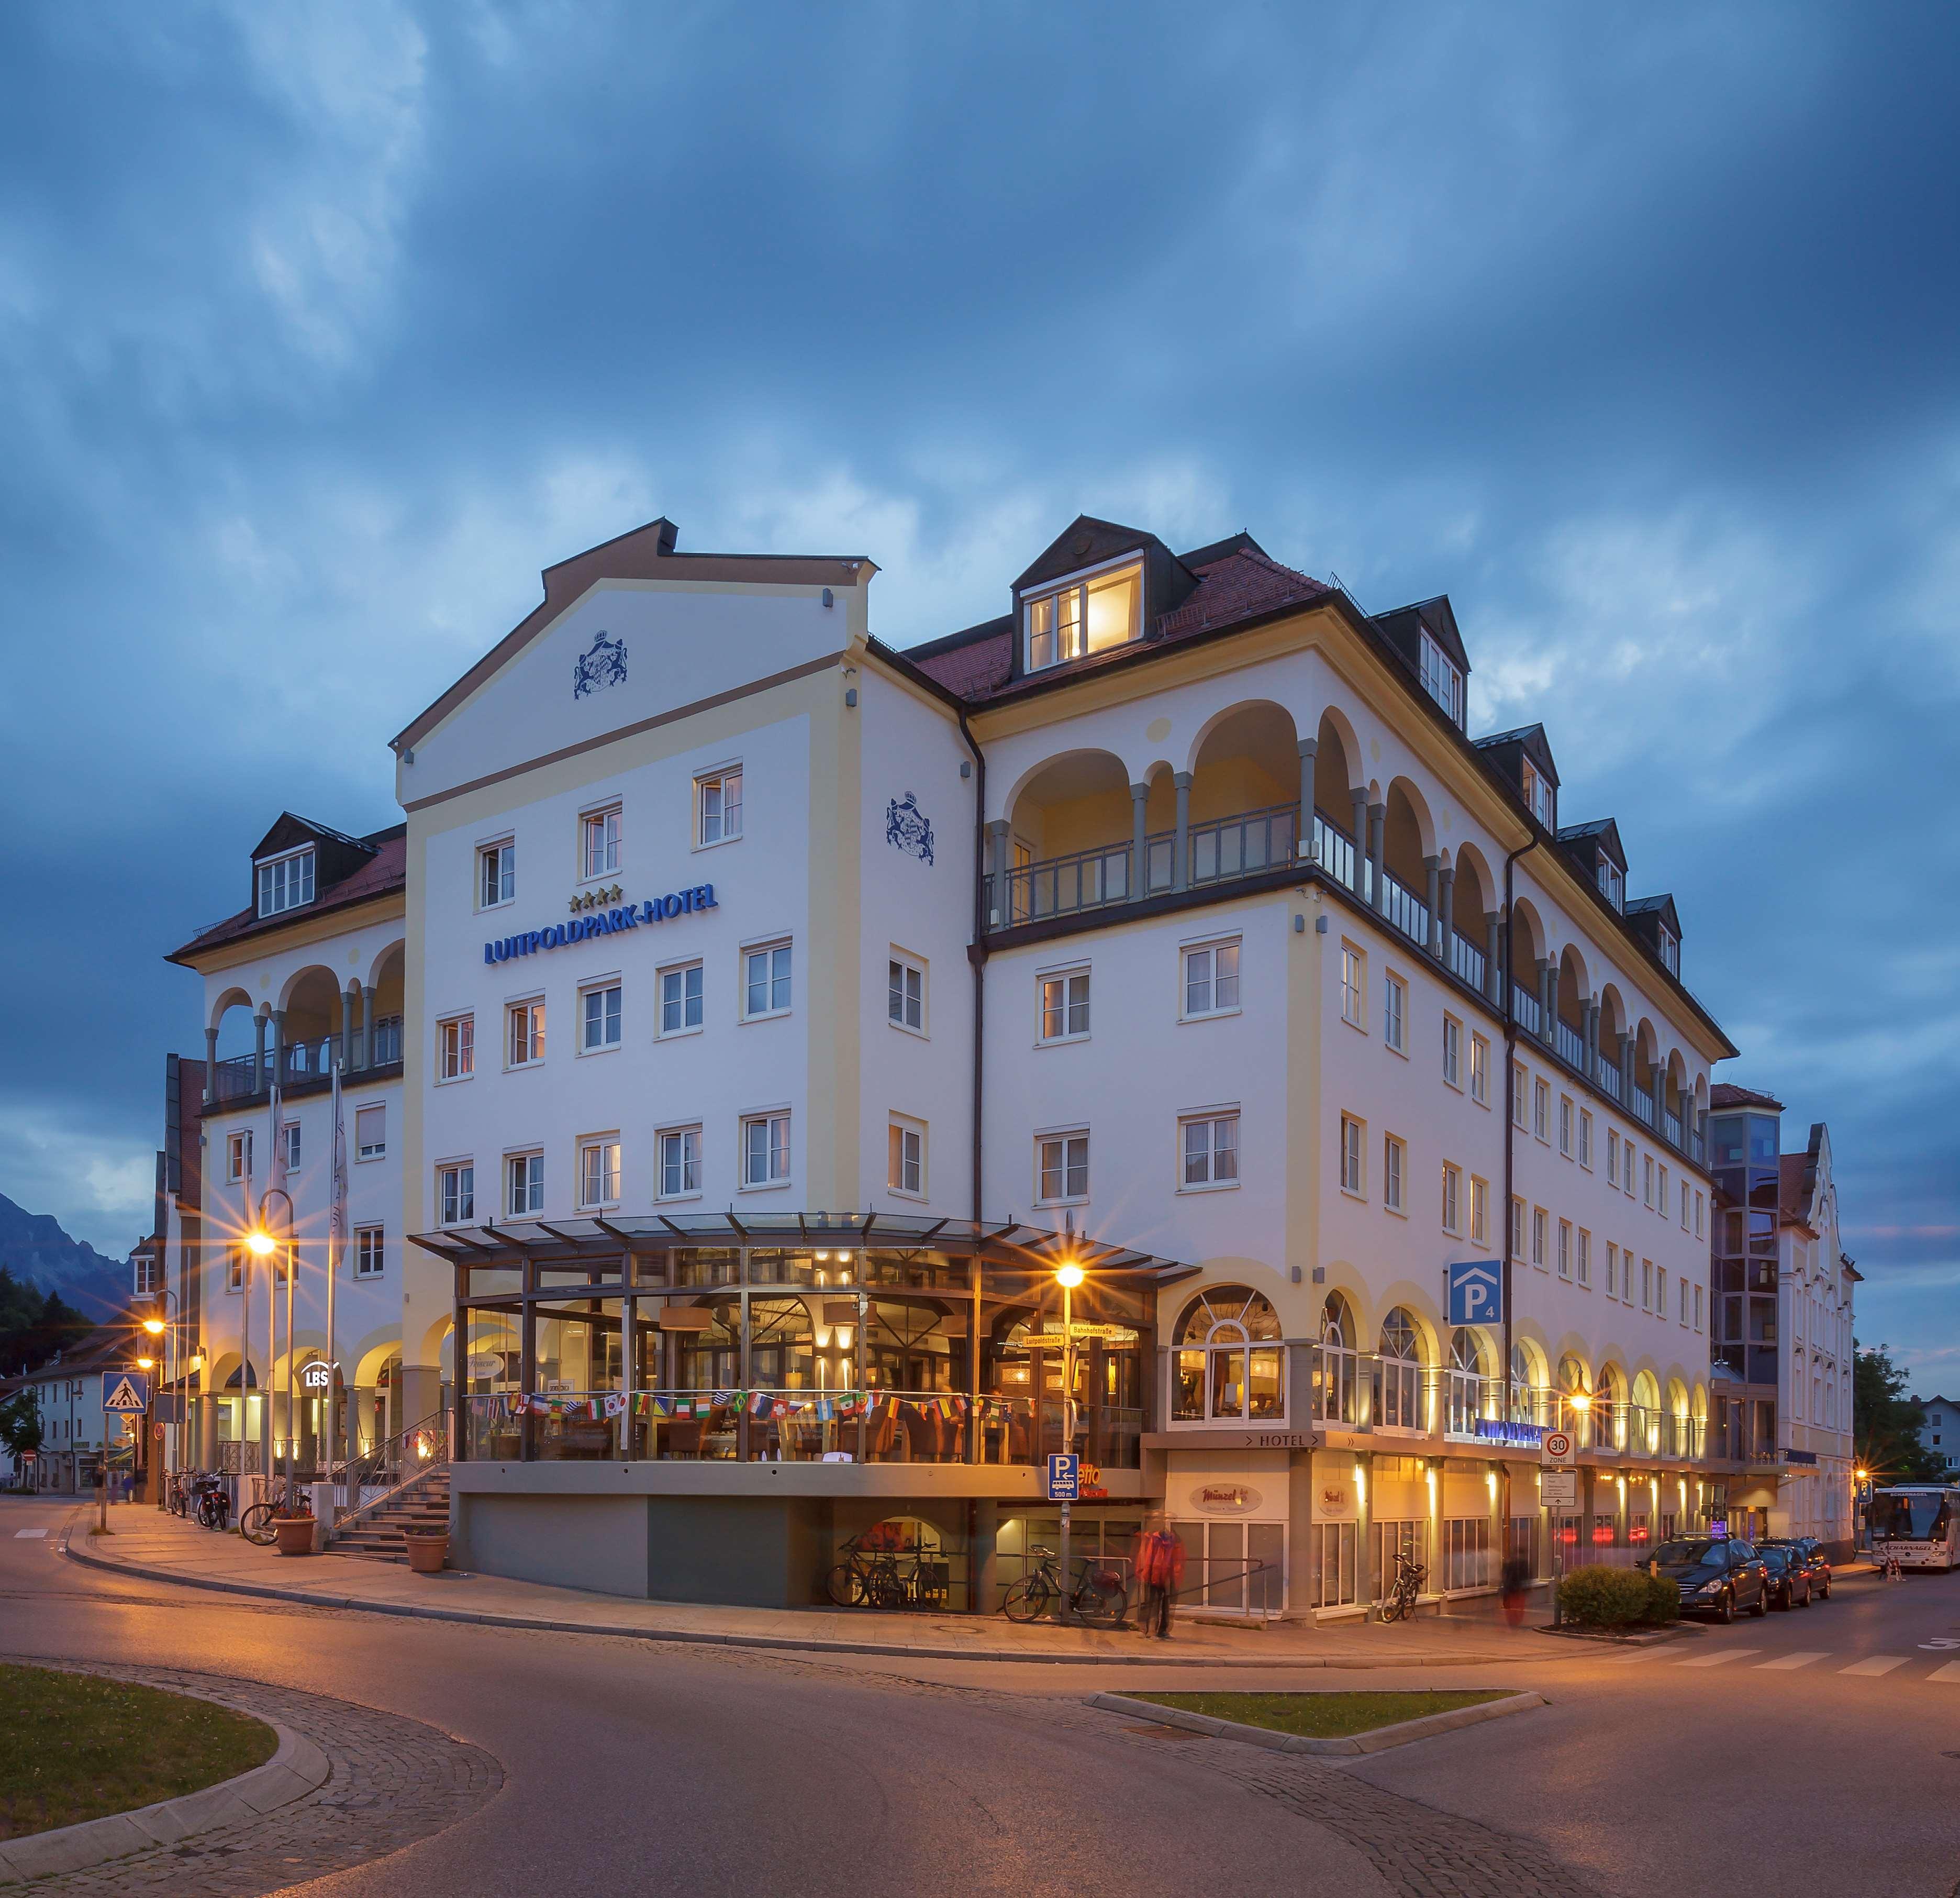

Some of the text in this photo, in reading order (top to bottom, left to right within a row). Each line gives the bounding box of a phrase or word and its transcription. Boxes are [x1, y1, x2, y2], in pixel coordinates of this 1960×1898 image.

[484, 883, 719, 965] LUITPOLDPARK-HOTEL
[1465, 1283, 1495, 1319] P 4
[1073, 1326, 1112, 1335] Bahnhofstraße
[305, 1370, 328, 1386] LBS
[1260, 1435, 1305, 1447] HOTEL
[1551, 1440, 1565, 1450] 30
[1055, 1456, 1071, 1478] P
[1078, 1464, 1100, 1484] etto
[1202, 1488, 1237, 1503] Münzel
